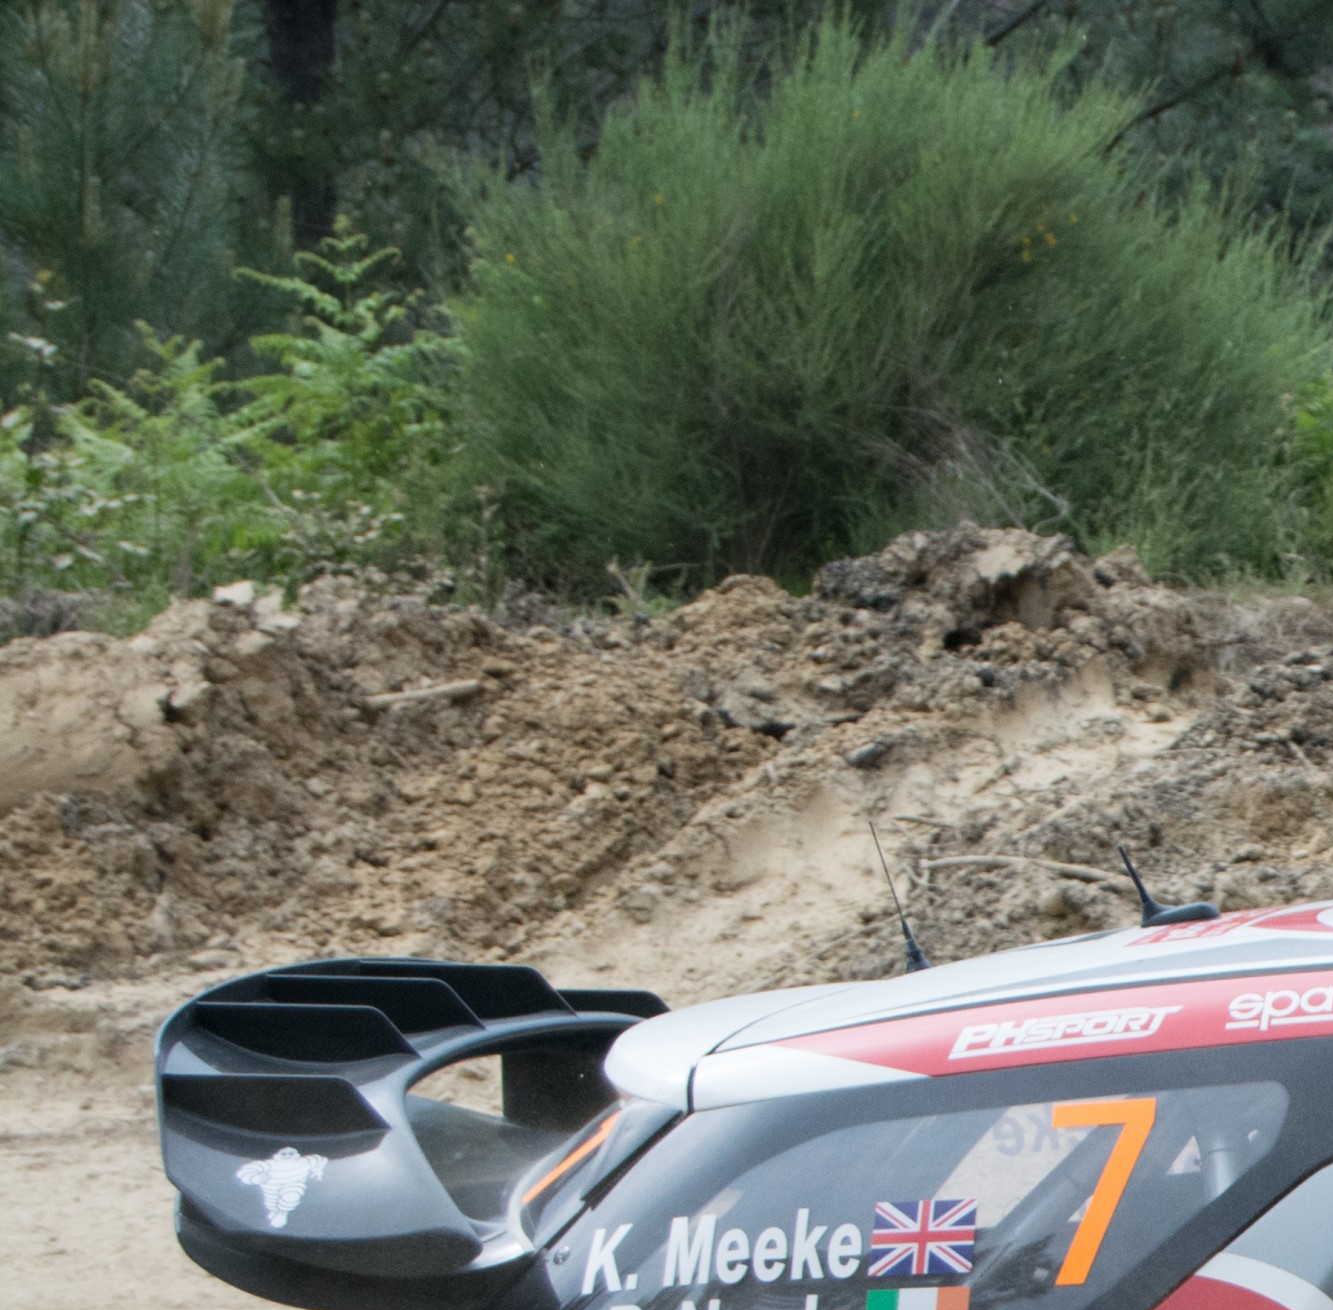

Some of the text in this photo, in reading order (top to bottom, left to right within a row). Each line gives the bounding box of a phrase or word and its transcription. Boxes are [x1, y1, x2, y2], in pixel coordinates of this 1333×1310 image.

[581, 1208, 863, 1296] K. Meeke
[1053, 1098, 1156, 1286] 7
